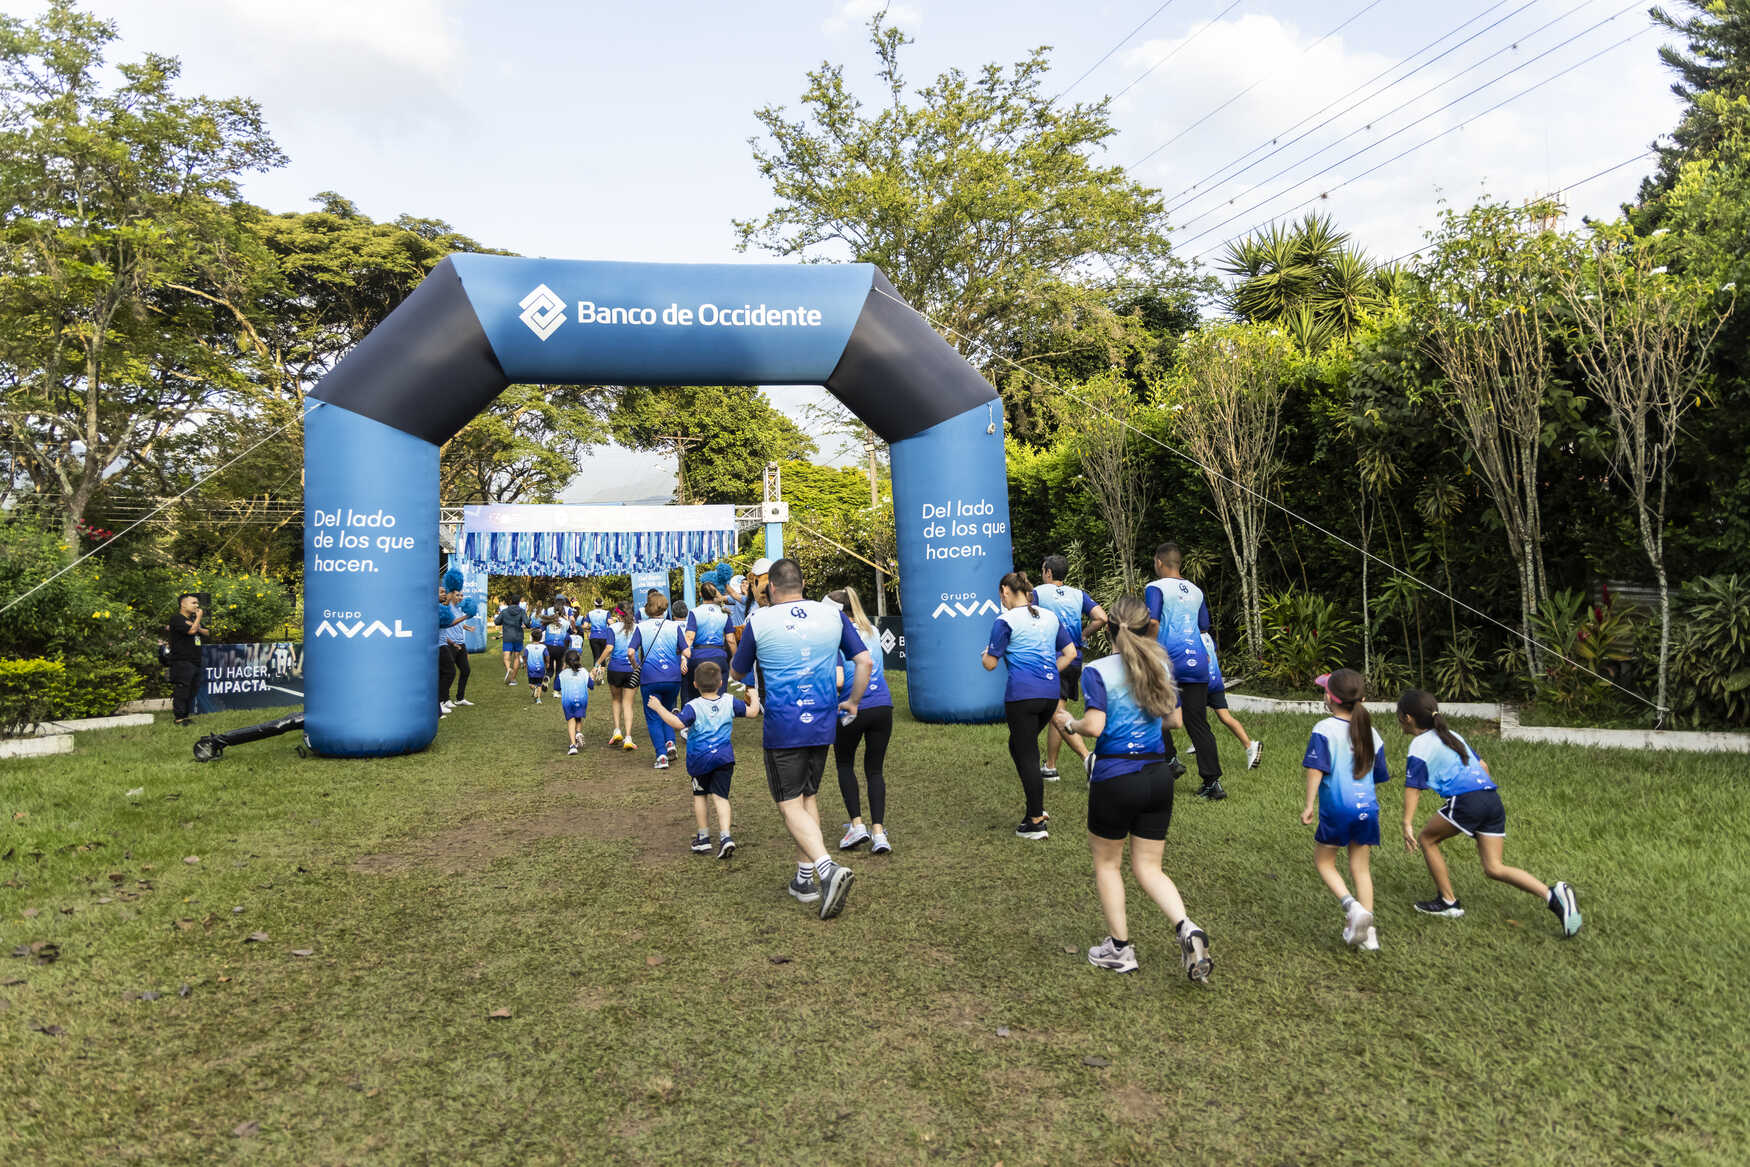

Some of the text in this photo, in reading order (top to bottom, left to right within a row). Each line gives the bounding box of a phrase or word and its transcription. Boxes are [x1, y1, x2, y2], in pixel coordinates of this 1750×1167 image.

[577, 301, 822, 327] Banco de Occidente
[314, 508, 396, 528] Del lado
[922, 498, 994, 519] Del lado
[923, 520, 1006, 539] de los que
[313, 530, 415, 553] de los que
[926, 543, 986, 561] hacen.
[314, 553, 379, 573] hacen.
[940, 592, 977, 601] Grupo
[323, 609, 363, 620] Grupo
[931, 600, 1003, 619] AVA
[315, 619, 413, 639] AVAL
[205, 667, 222, 679] TU
[207, 679, 271, 695] IMPACTA.
